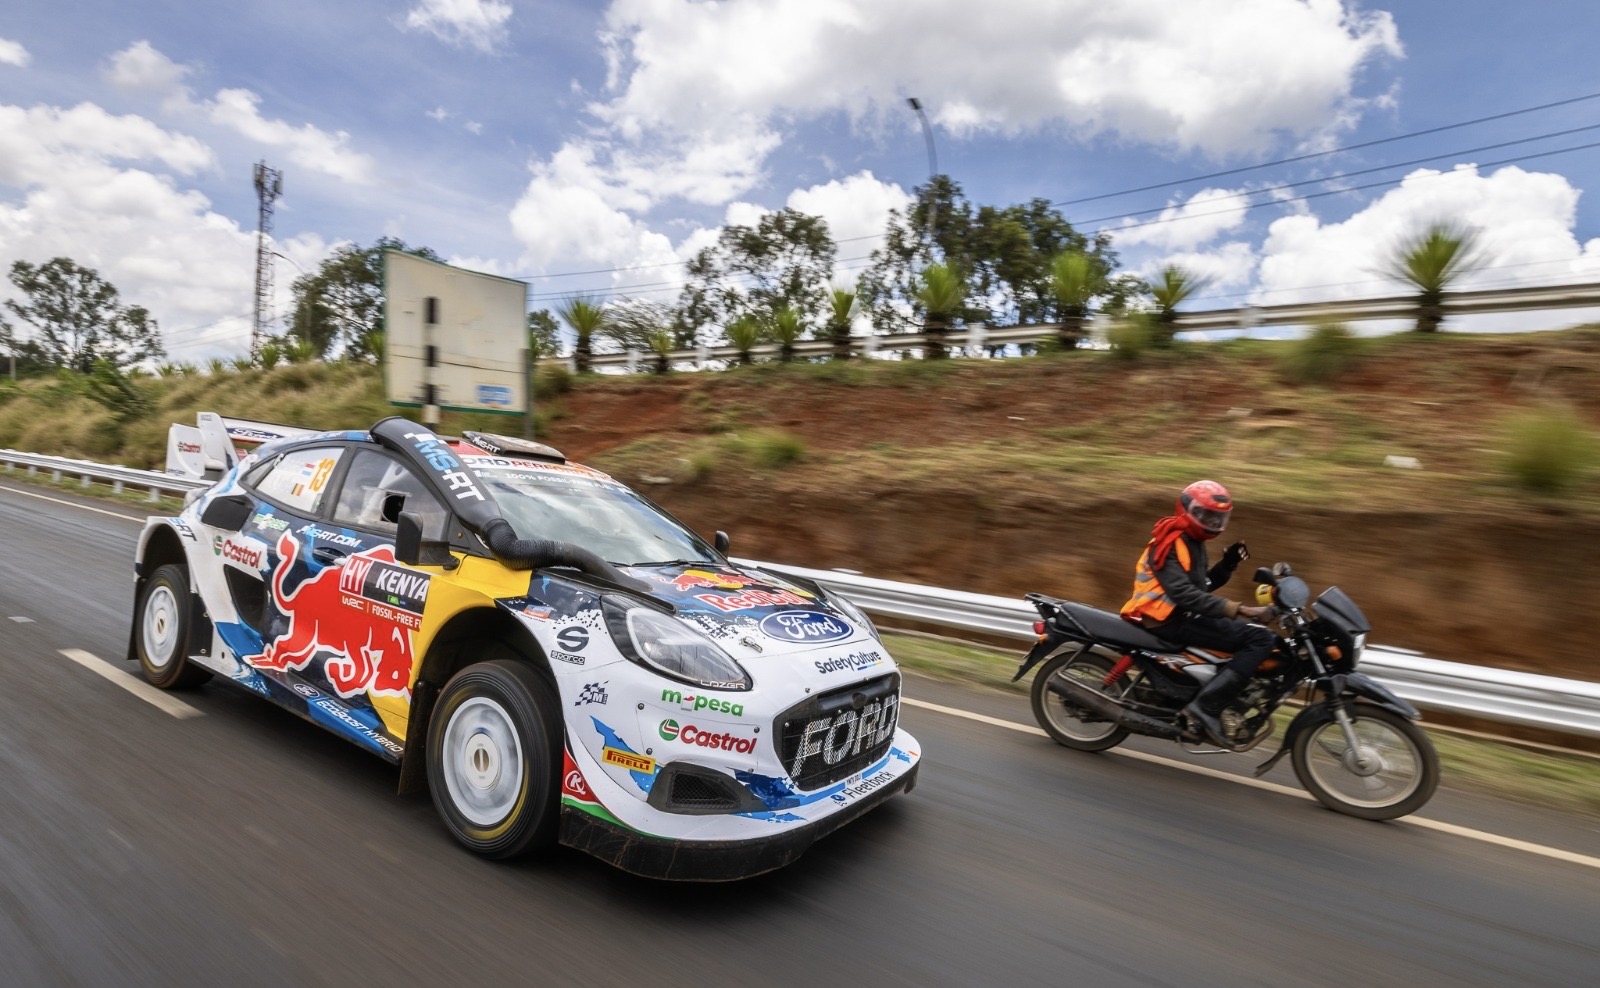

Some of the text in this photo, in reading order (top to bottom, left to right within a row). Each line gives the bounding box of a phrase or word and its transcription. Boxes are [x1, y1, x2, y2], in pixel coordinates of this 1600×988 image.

[308, 458, 335, 492] 13
[414, 440, 486, 500] MS-RT
[462, 457, 510, 467] ORD
[169, 518, 198, 542] S-RT
[222, 539, 262, 569] Castrol
[342, 559, 430, 602] HY KENYA
[372, 604, 413, 627] FOSSIL-FREE
[777, 613, 842, 639] Ford
[814, 651, 882, 674] SafetyCulture
[701, 680, 746, 690] LAZER
[363, 730, 404, 752] HYBRID
[680, 724, 758, 755] Castrol
[791, 694, 898, 778] FORD
[606, 750, 651, 771] PIRELLI
[842, 771, 896, 799] Fleetback
